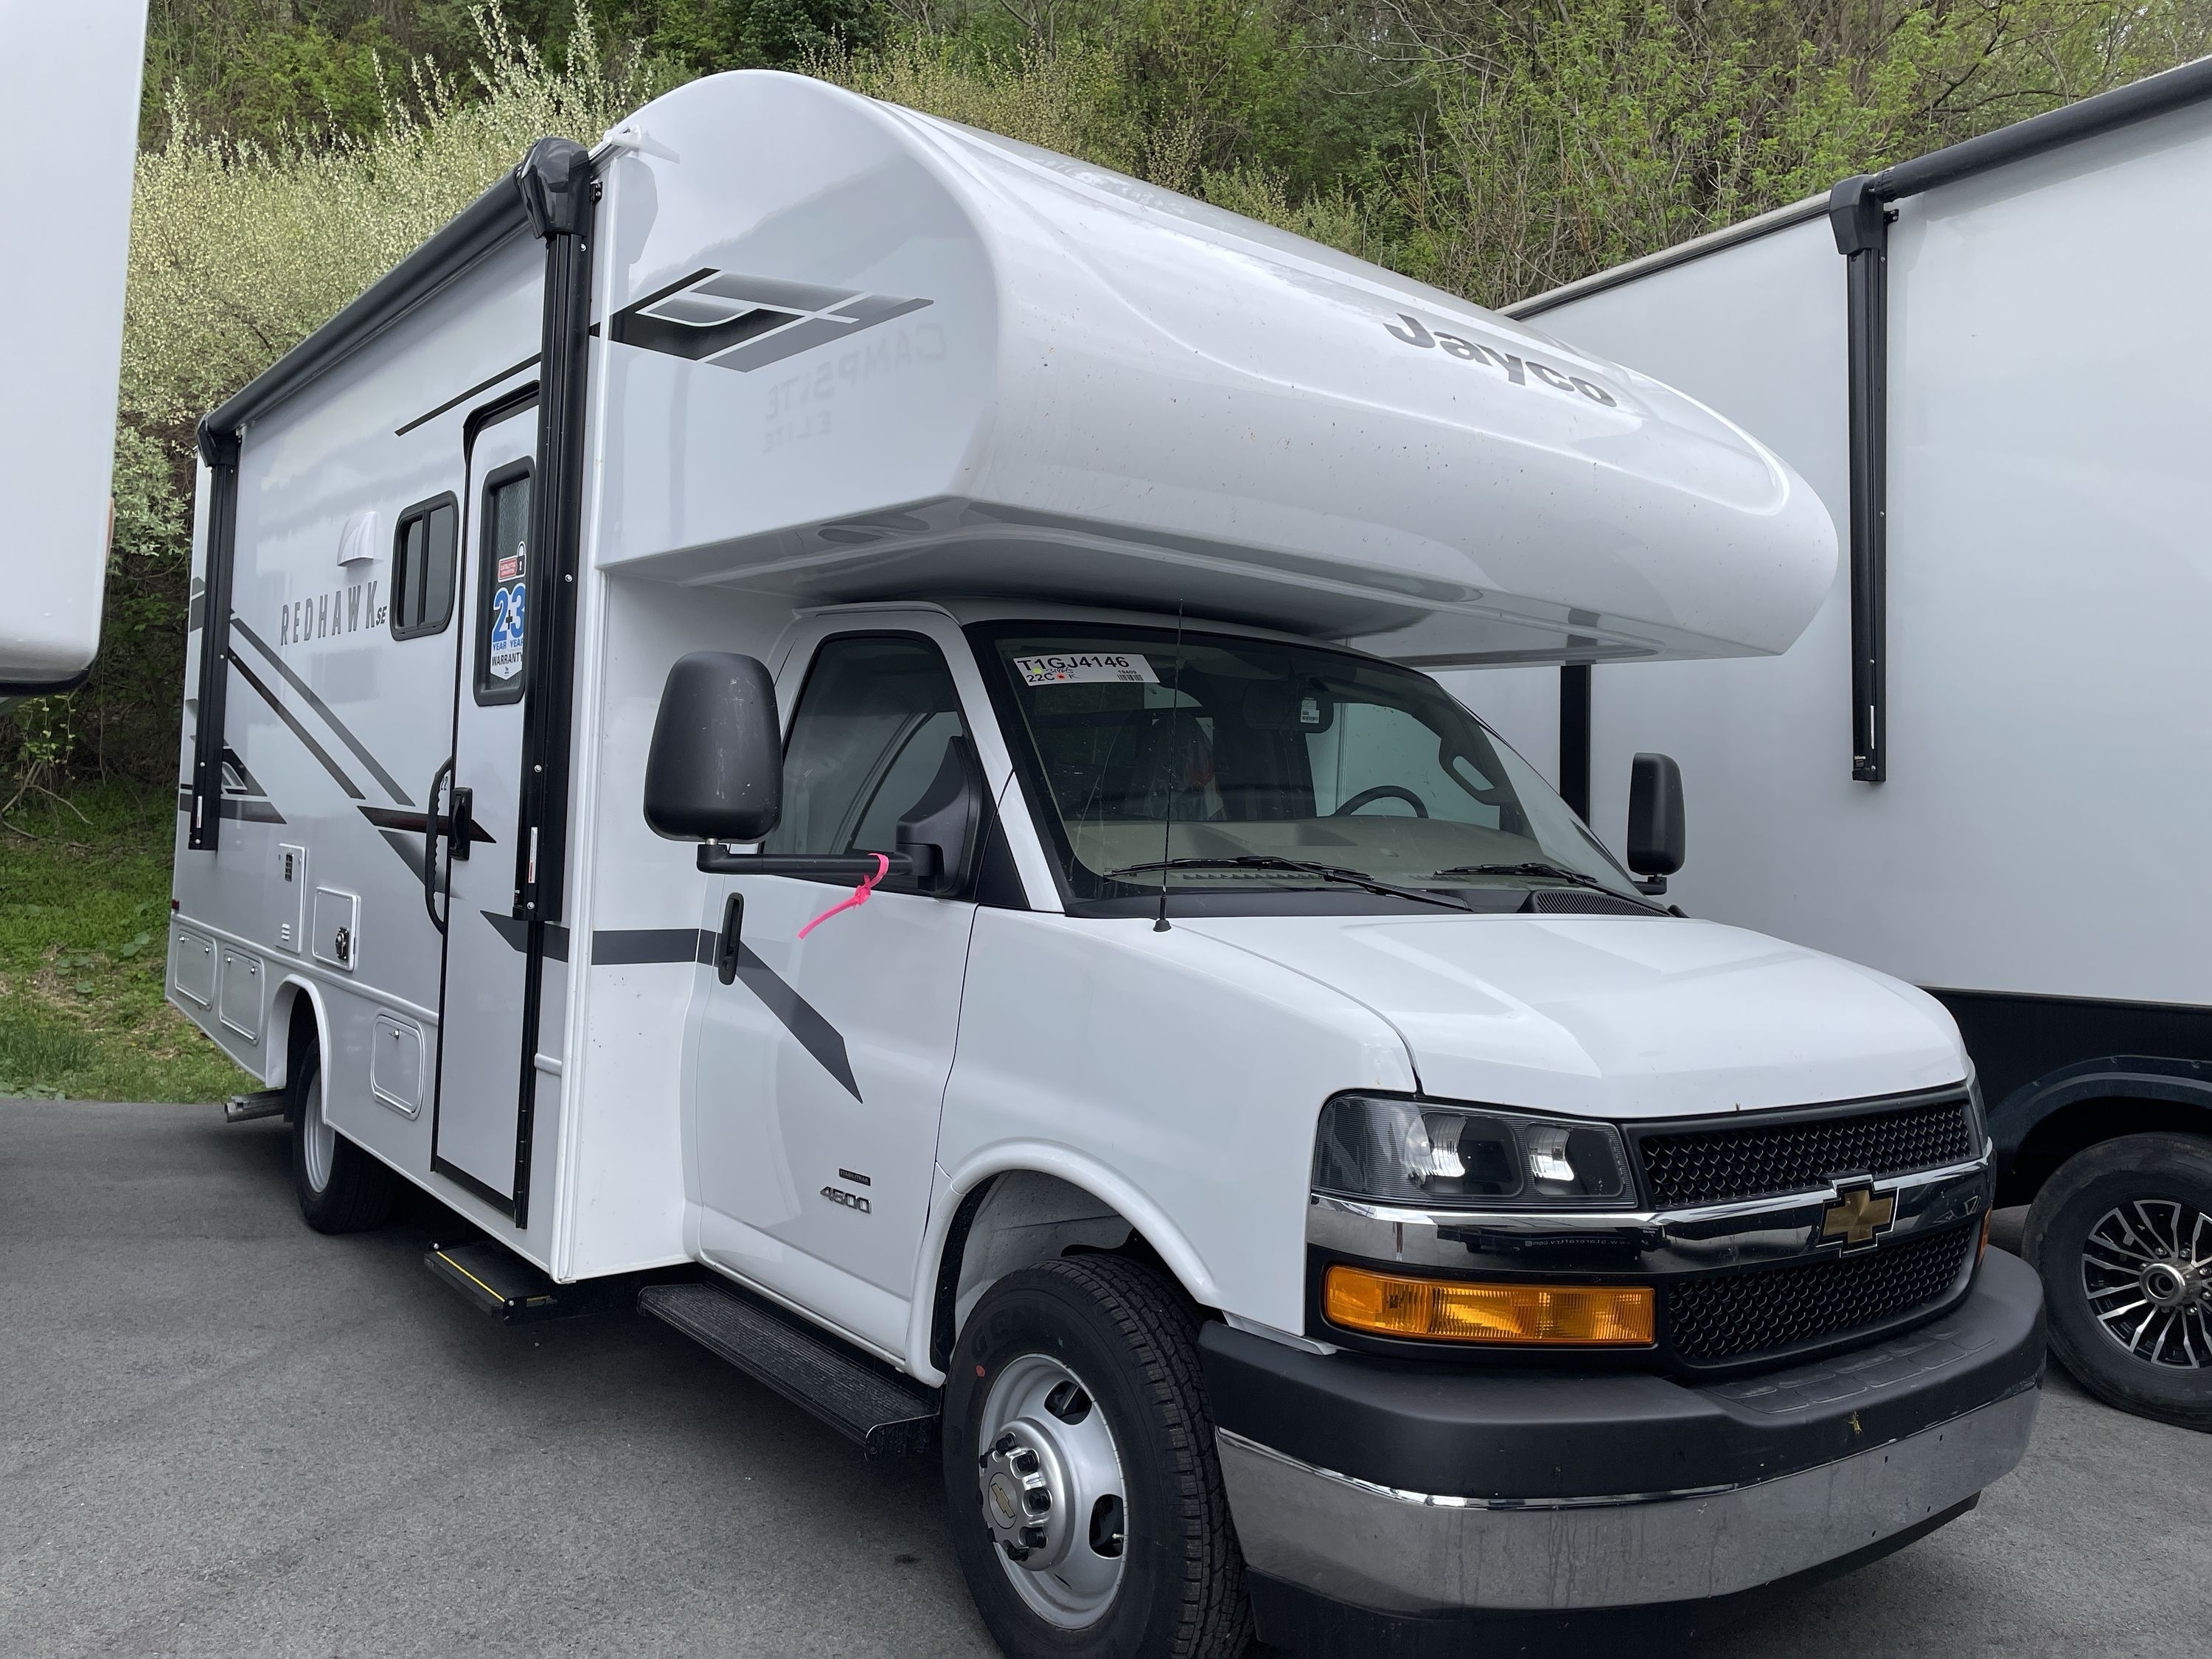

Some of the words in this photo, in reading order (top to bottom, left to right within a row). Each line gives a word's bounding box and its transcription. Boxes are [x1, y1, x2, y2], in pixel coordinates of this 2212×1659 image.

[1382, 313, 1617, 407] Jayco
[281, 580, 378, 646] REDHAWK
[376, 606, 387, 625] SE
[493, 641, 507, 651] YEAR
[492, 652, 523, 667] WARRANTY
[1017, 655, 1130, 672] T1GJ4146
[1026, 672, 1055, 683] 22C
